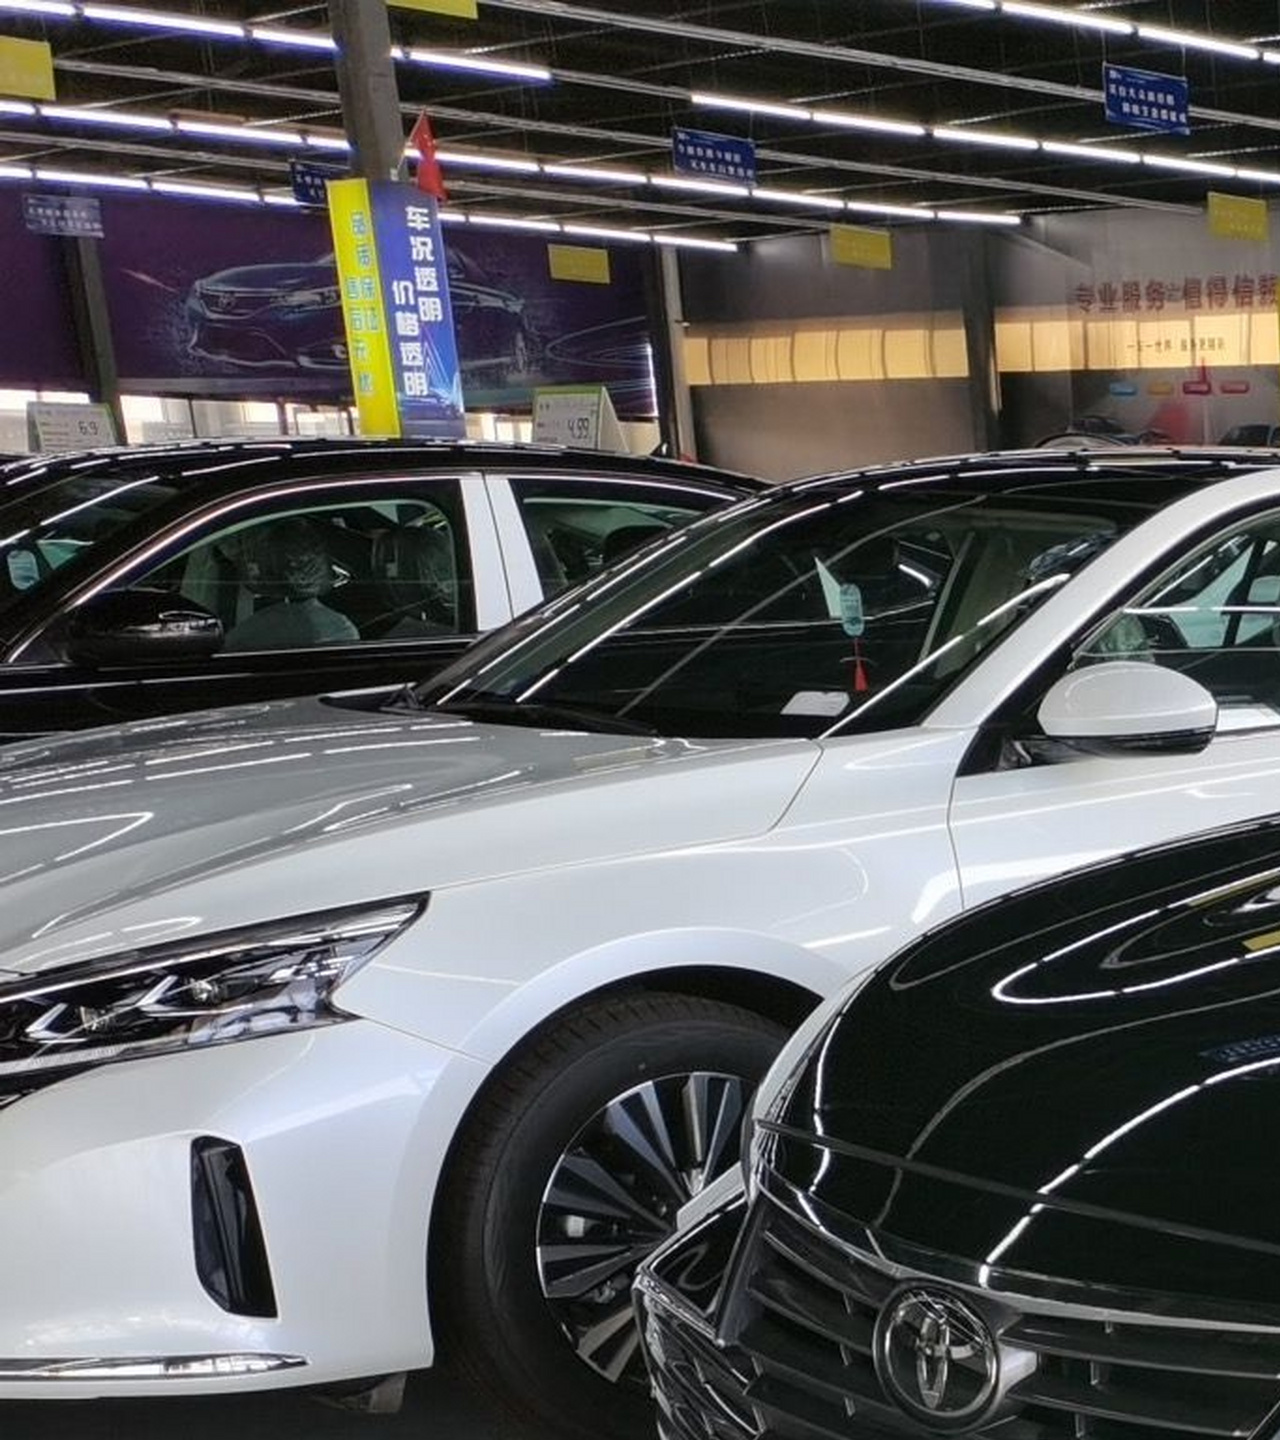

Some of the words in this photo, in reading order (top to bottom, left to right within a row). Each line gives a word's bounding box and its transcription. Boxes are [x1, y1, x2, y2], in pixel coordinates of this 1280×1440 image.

[405, 206, 443, 322] 车况透明
[1075, 279, 1166, 312] 专业服务
[1183, 274, 1279, 310] 值得信赖
[392, 280, 429, 396] 价格透明
